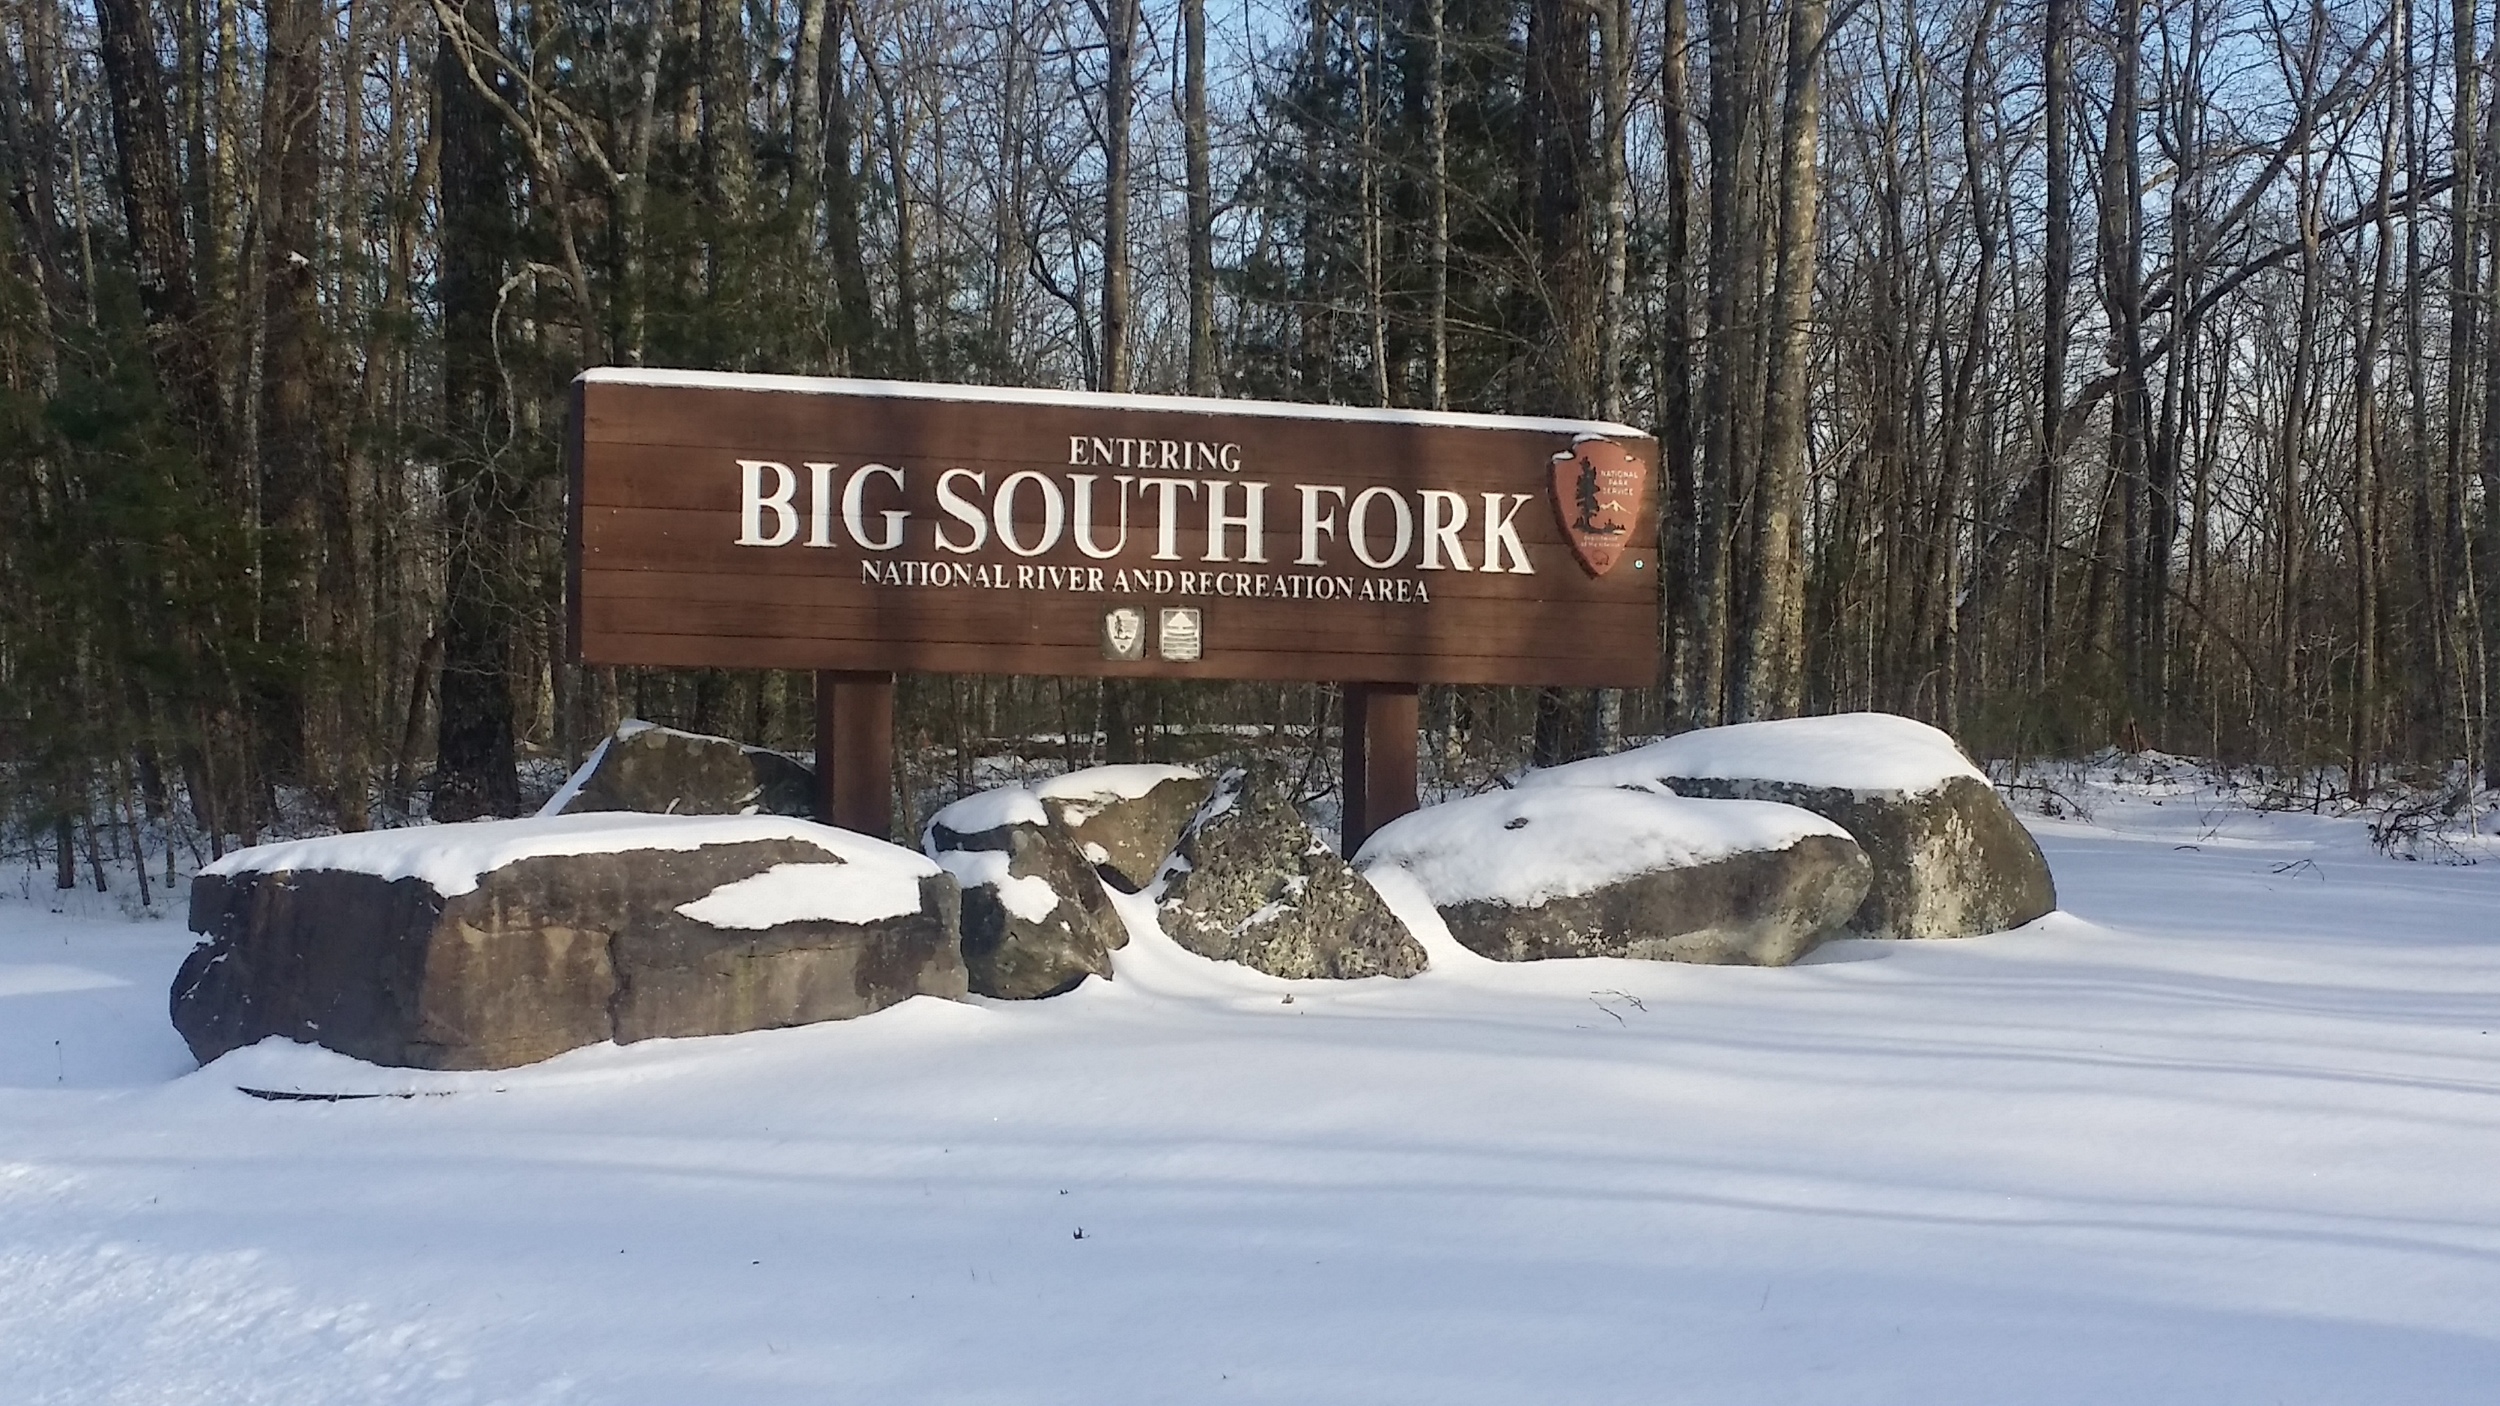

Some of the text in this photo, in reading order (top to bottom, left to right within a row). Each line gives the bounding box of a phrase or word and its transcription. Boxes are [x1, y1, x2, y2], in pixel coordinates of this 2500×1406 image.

[1068, 435, 1242, 472] ENTERING
[1601, 470, 1638, 478] NATIONAL
[734, 459, 1536, 574] BIG SOUTH FORK
[861, 559, 1430, 603] NATIONAL RIVER AND RECREATION AREA
